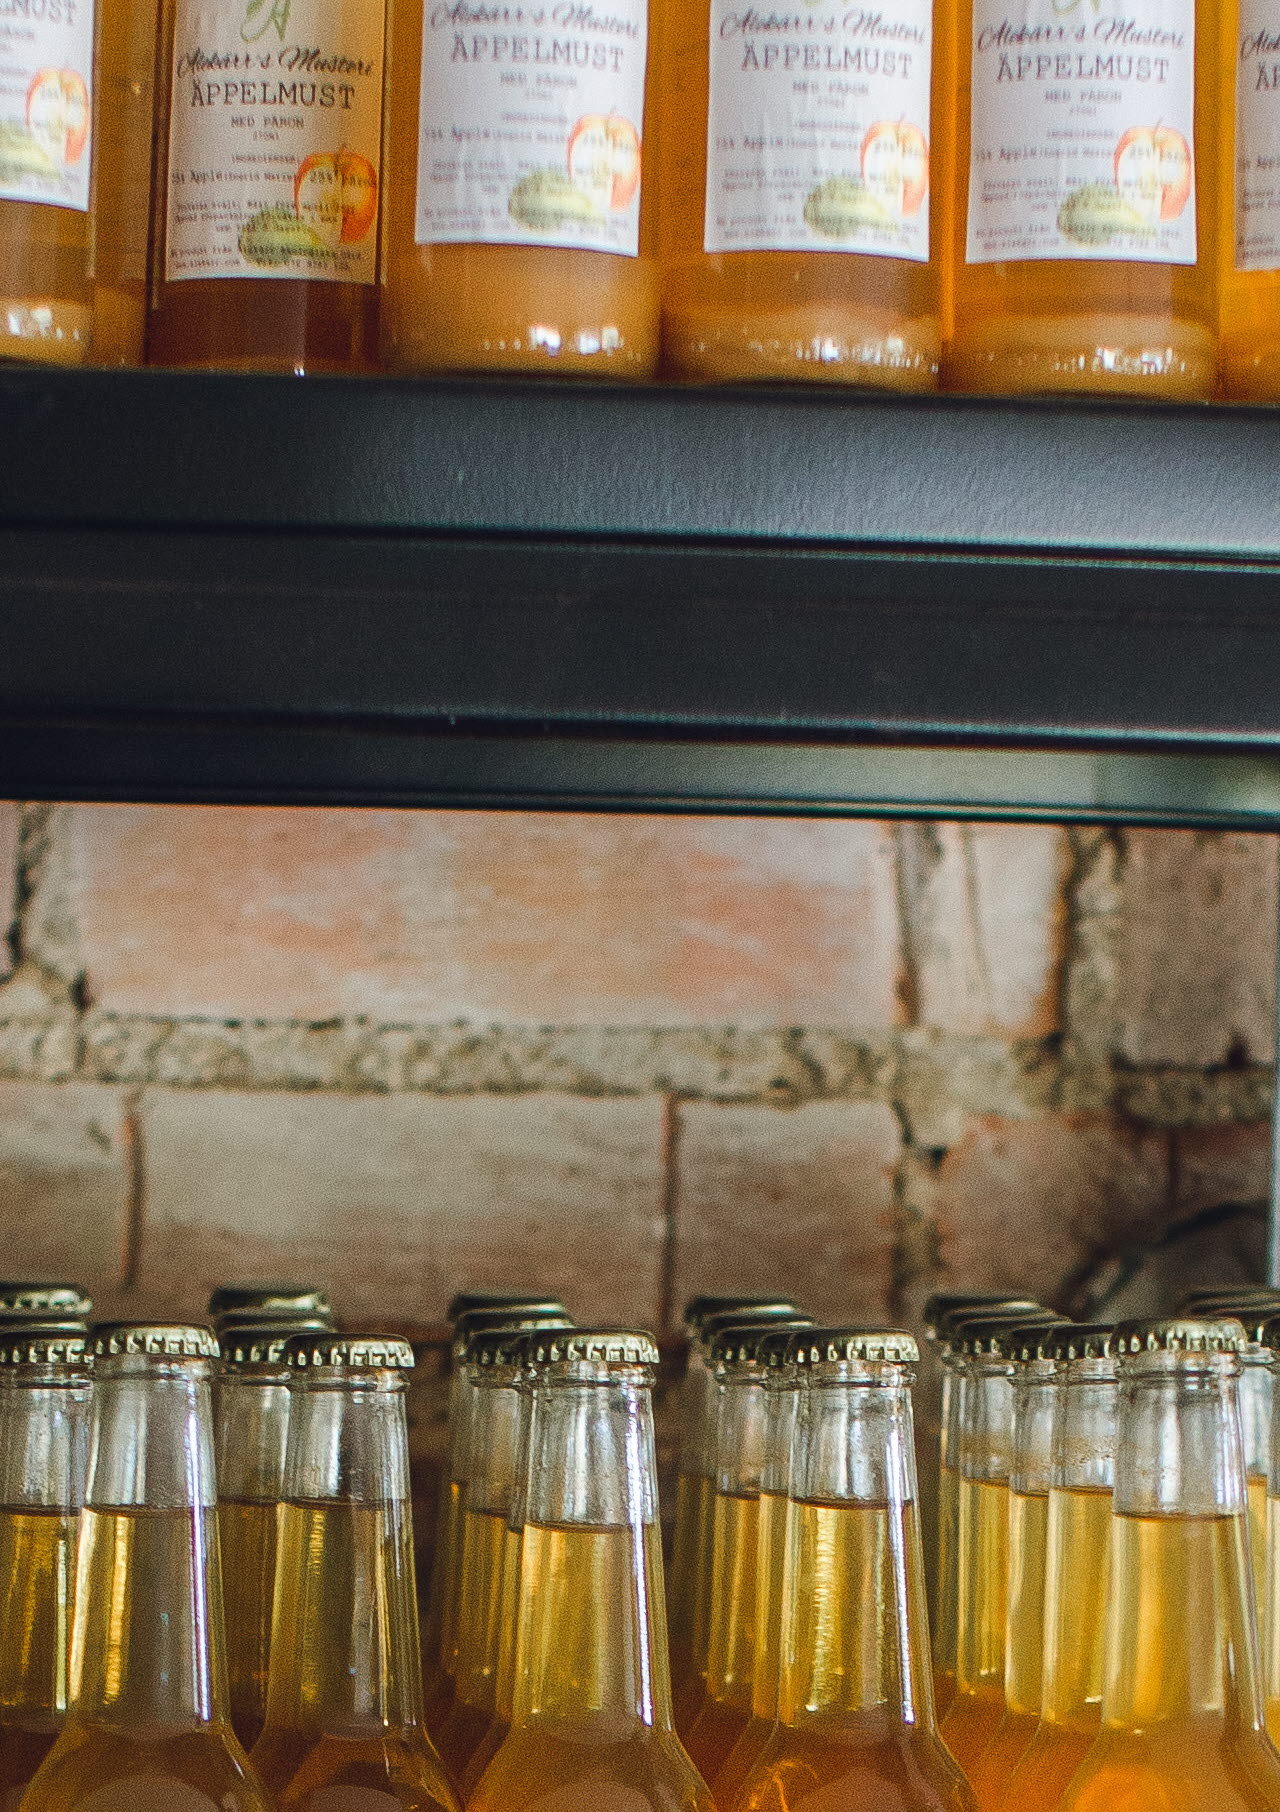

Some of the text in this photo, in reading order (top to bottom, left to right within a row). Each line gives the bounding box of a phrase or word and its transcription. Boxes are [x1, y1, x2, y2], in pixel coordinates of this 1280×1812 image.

[451, 31, 624, 73] ÄPPELMUST
[742, 41, 912, 78] ÄPPELMUST
[997, 53, 1169, 83] ÄPPELMUST
[190, 78, 355, 110] ÄPPELMUST
